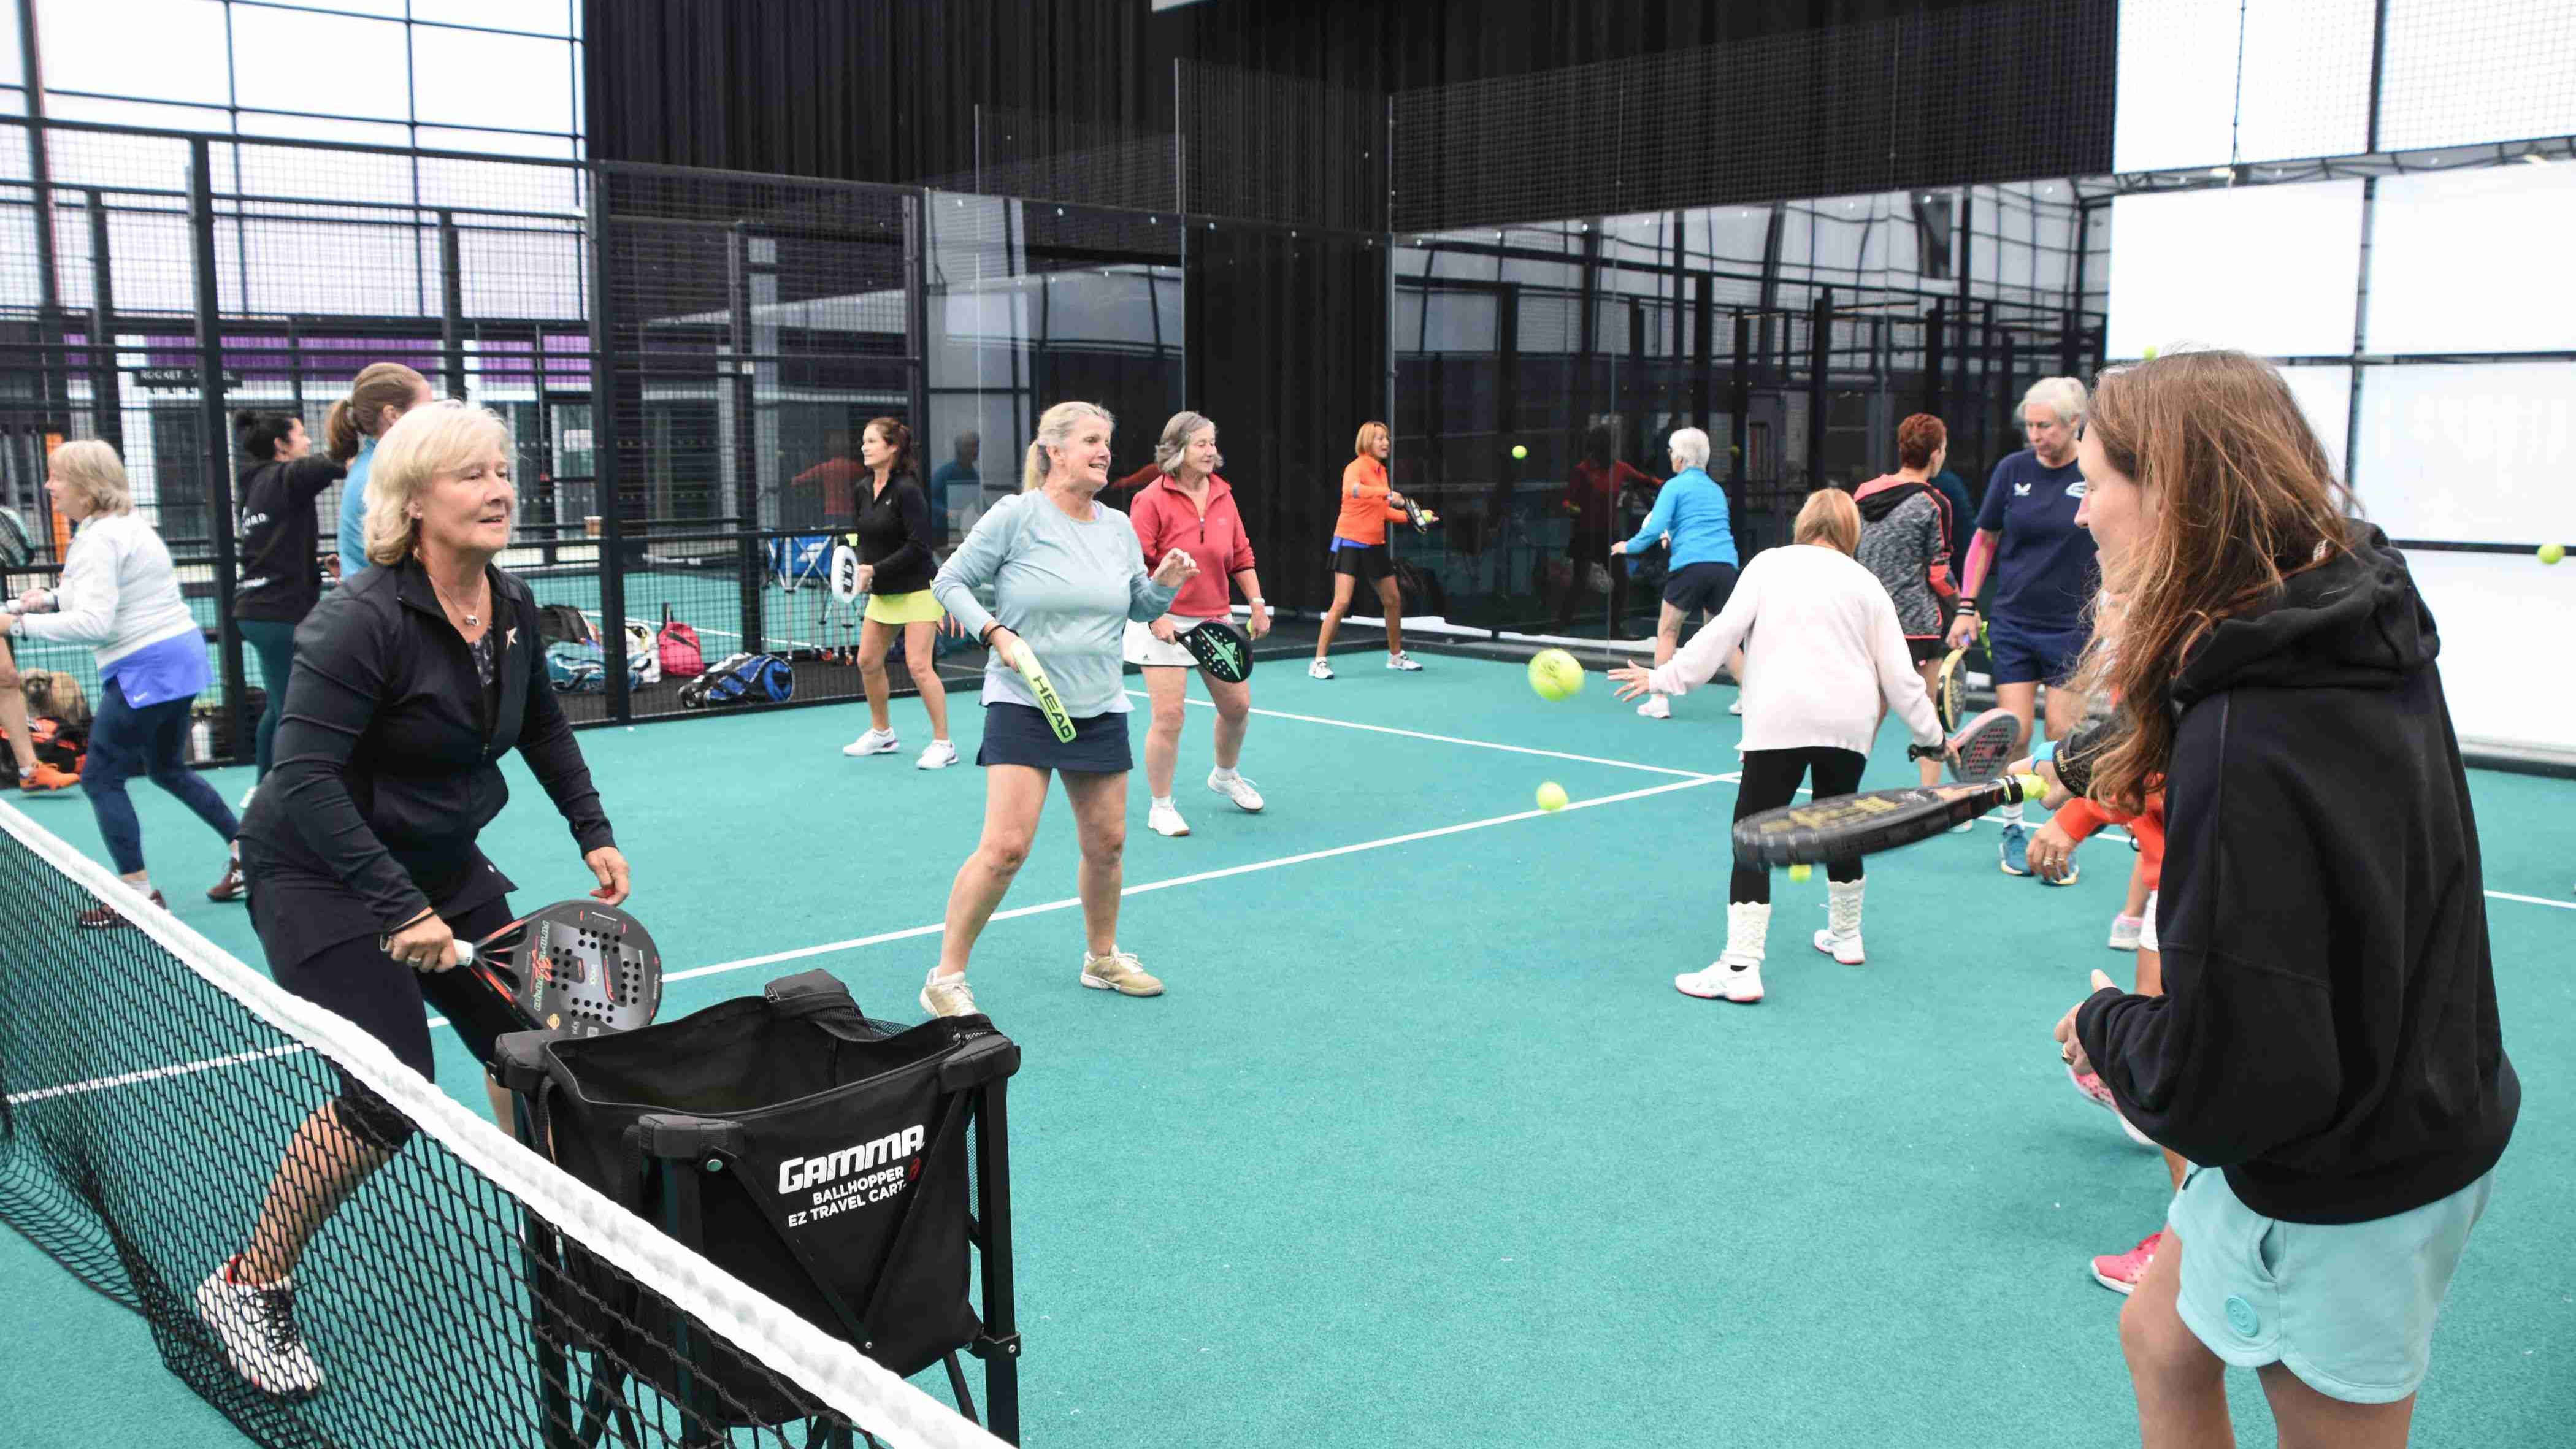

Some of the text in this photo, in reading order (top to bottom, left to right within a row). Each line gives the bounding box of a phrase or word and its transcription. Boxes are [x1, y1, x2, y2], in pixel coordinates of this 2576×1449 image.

[1033, 675, 1071, 738] HEAD
[778, 1125, 924, 1195] GAMMA
[813, 1166, 905, 1206] BALLHOPPER
[788, 1180, 904, 1227] EZ TRAVEL CART
